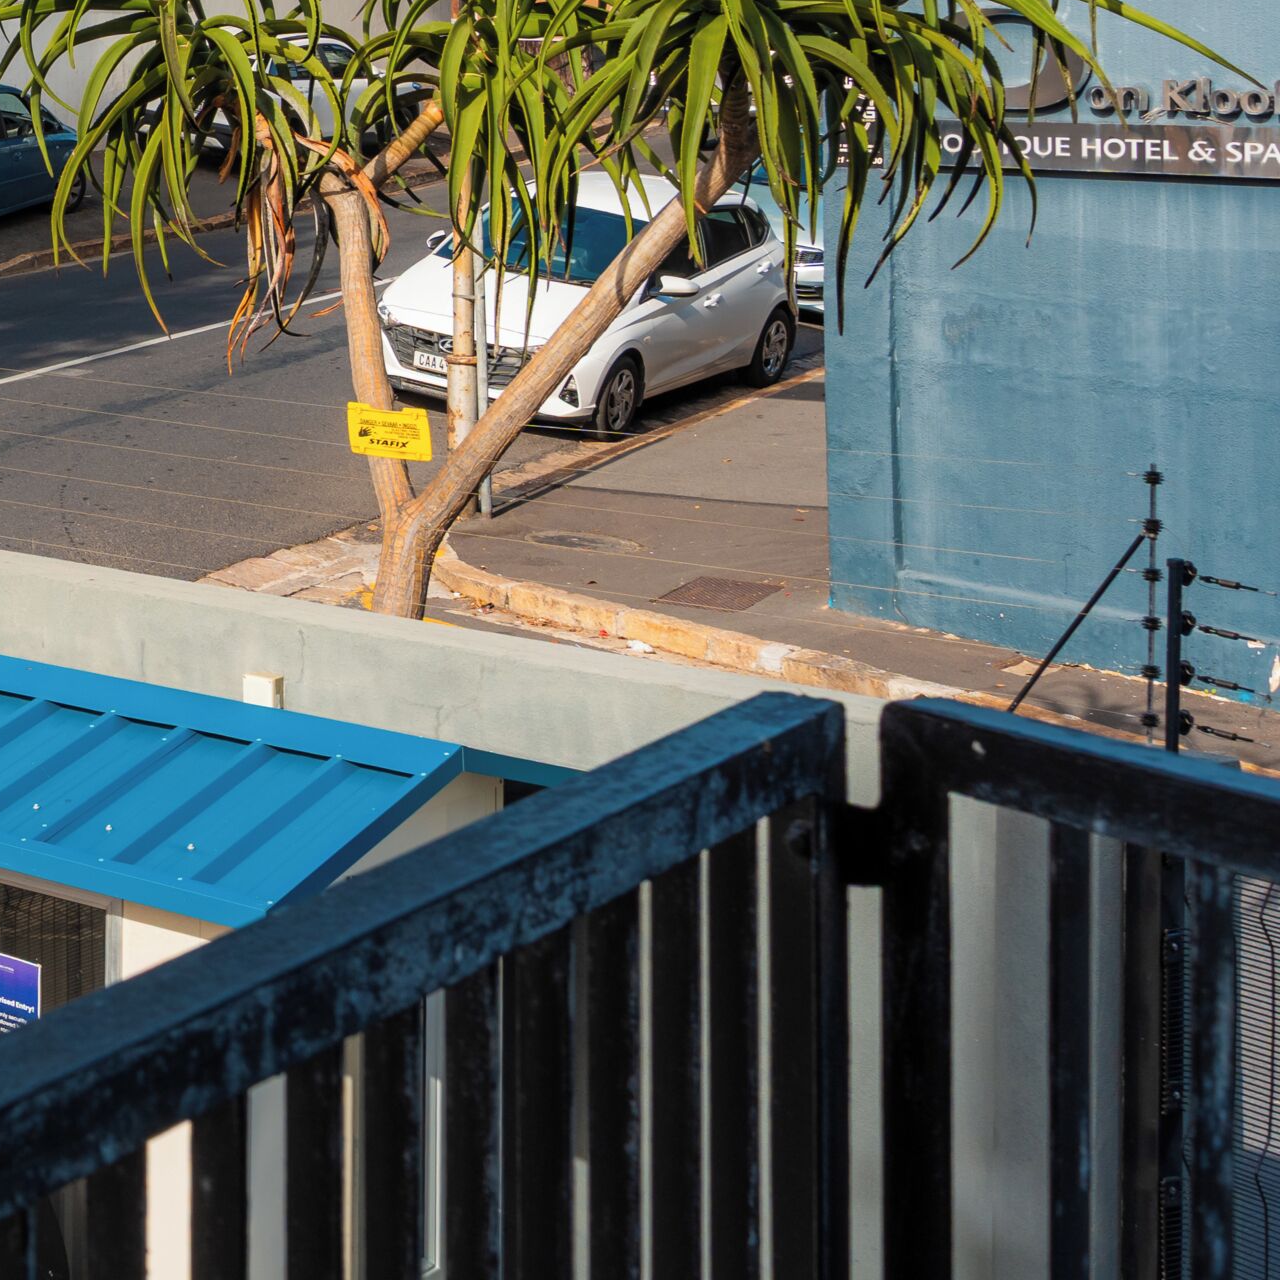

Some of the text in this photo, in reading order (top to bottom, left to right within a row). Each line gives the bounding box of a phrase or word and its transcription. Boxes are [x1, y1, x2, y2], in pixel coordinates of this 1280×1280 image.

[943, 8, 1149, 111] Don
[1162, 77, 1280, 116] Kloo
[1081, 137, 1179, 161] HOTEL
[1187, 140, 1216, 163] &
[1225, 141, 1280, 163] SPA
[419, 354, 436, 369] CAA
[368, 438, 409, 449] STAFIX
